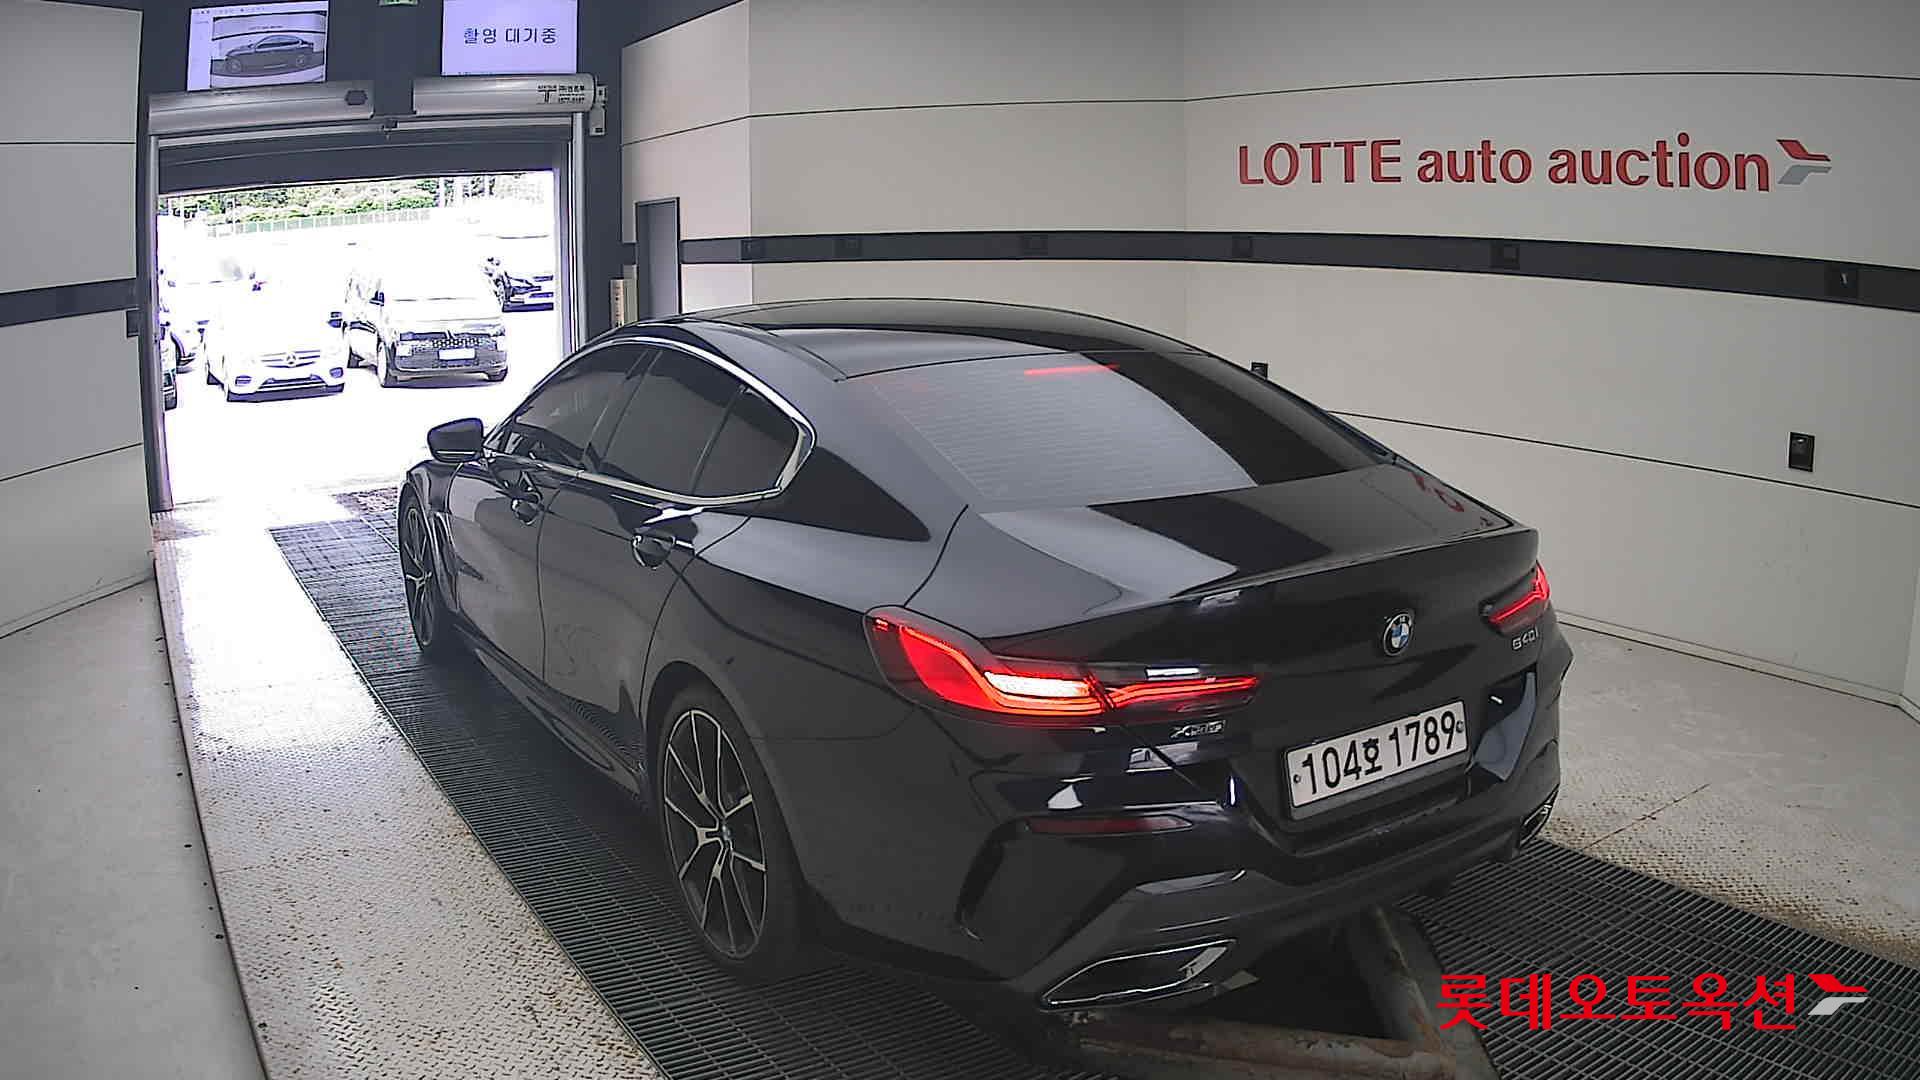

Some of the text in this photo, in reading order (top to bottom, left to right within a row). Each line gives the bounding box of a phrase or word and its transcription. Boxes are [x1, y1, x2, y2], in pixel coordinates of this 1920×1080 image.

[464, 27, 557, 44] 촬영 대기중
[1239, 132, 1770, 192] LOTTE auto auction
[1302, 711, 1455, 795] 104호 1789
